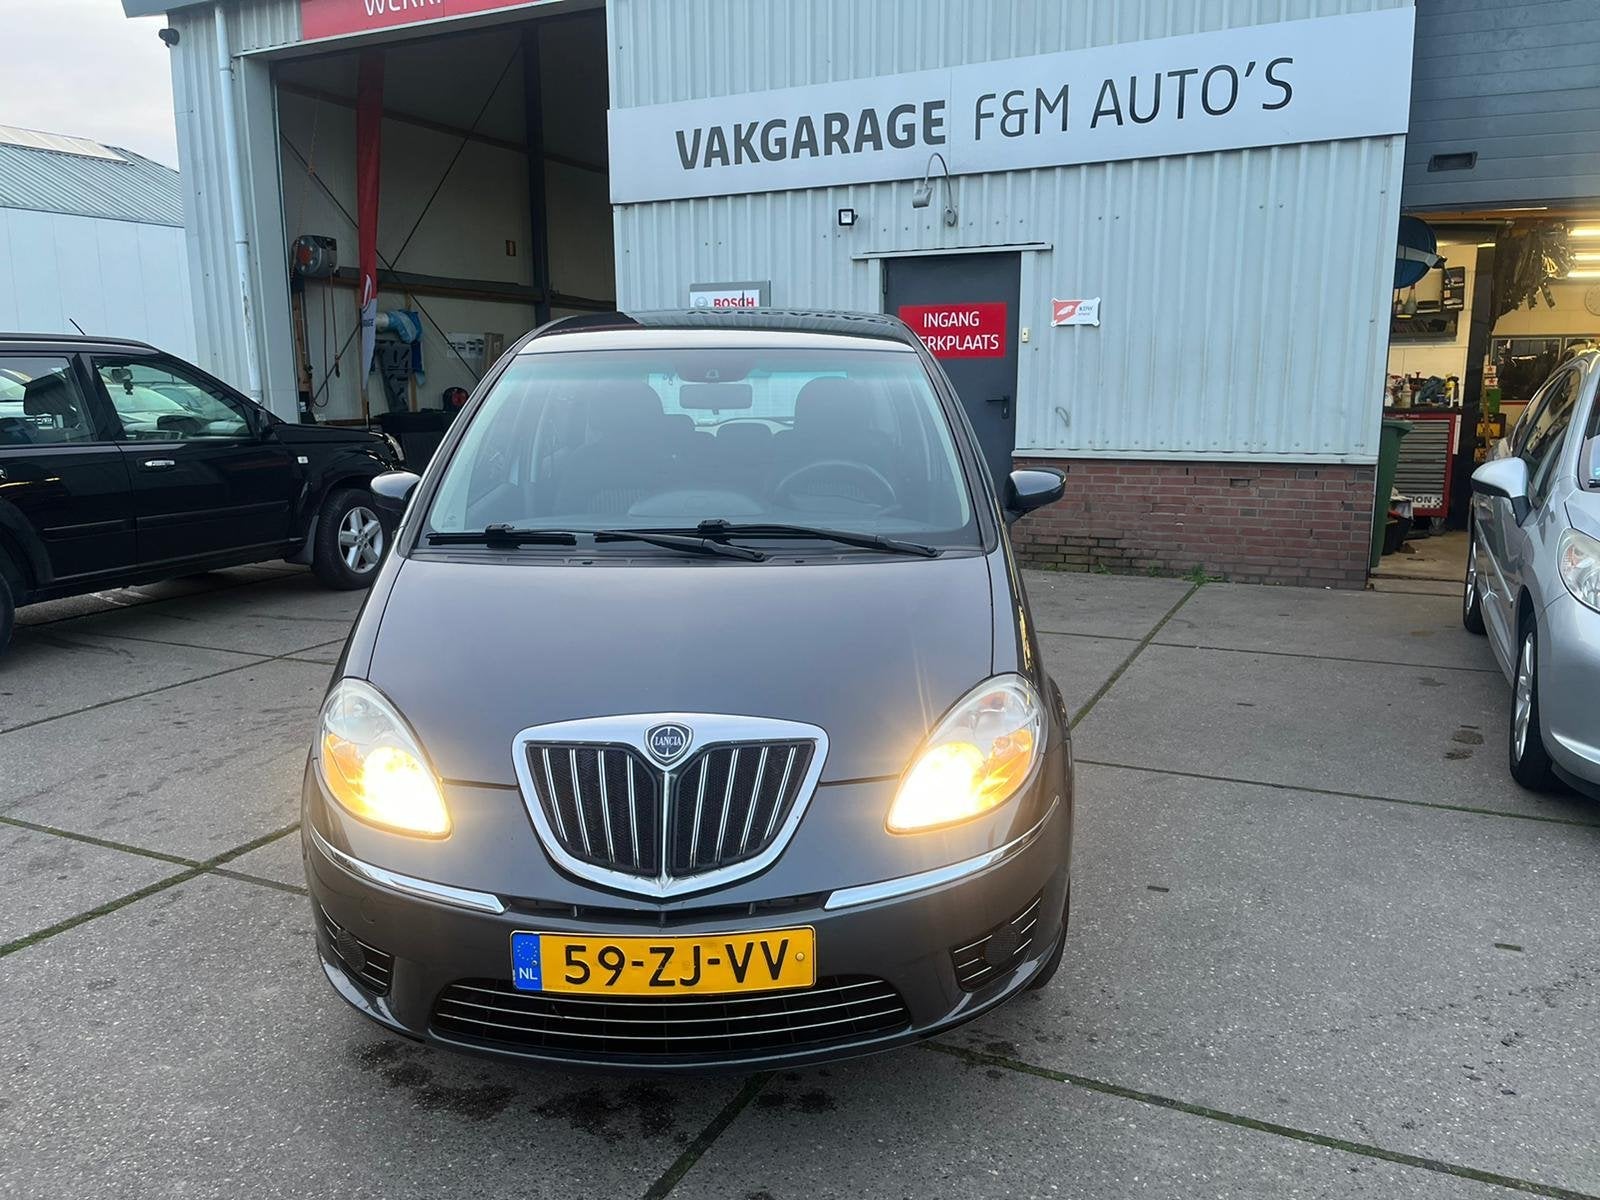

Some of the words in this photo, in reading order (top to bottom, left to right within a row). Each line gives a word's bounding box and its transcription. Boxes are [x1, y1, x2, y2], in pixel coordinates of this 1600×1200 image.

[675, 99, 946, 170] VAKGARAGE
[974, 84, 1070, 141] F&M
[1089, 57, 1294, 129] AUTO'S
[713, 297, 755, 308] BOSCH
[923, 310, 980, 328] INGANG
[919, 333, 1000, 351] RKPLAATS
[655, 736, 682, 746] LANCIA
[564, 938, 789, 988] 59-ZJ-VV
[518, 966, 539, 981] NL
